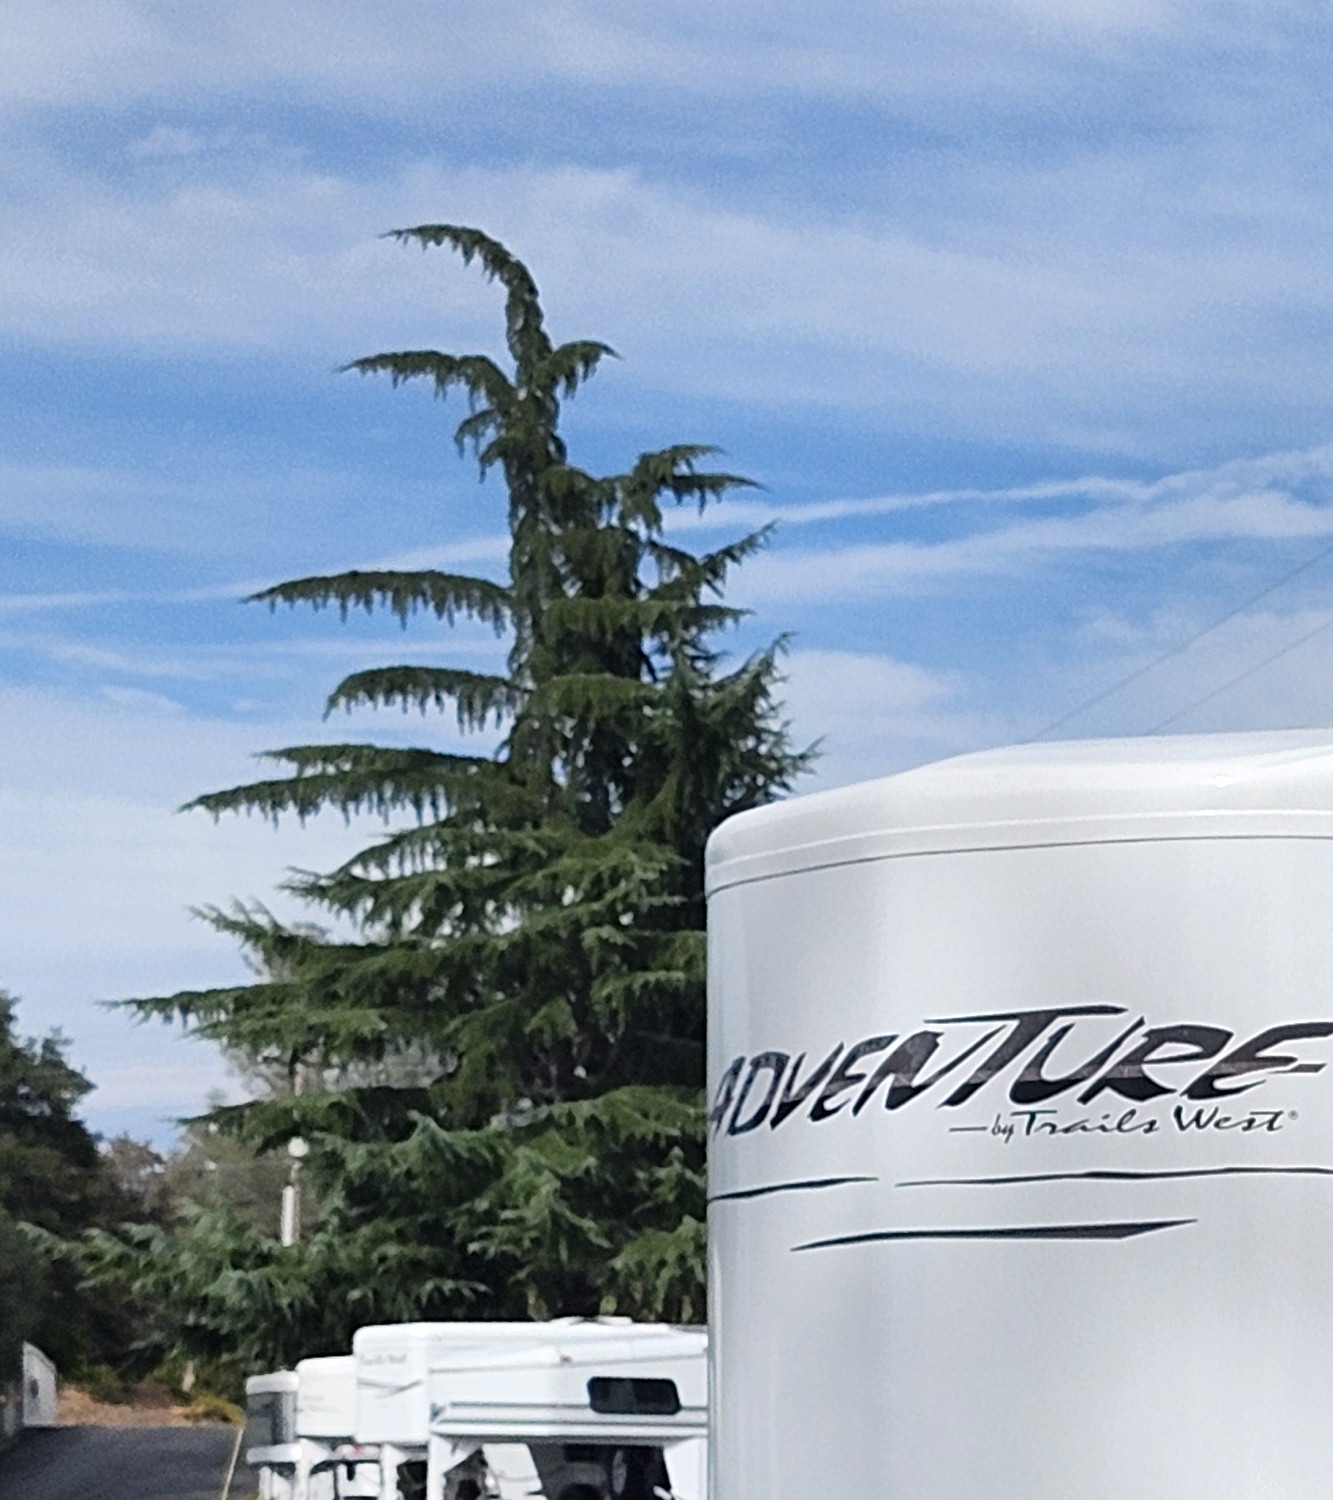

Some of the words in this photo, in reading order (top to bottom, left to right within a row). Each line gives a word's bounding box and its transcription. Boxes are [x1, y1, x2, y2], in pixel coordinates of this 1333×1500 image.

[992, 1113, 1014, 1143] by
[1011, 1109, 1159, 1136] Trails
[1174, 1105, 1284, 1132] West
